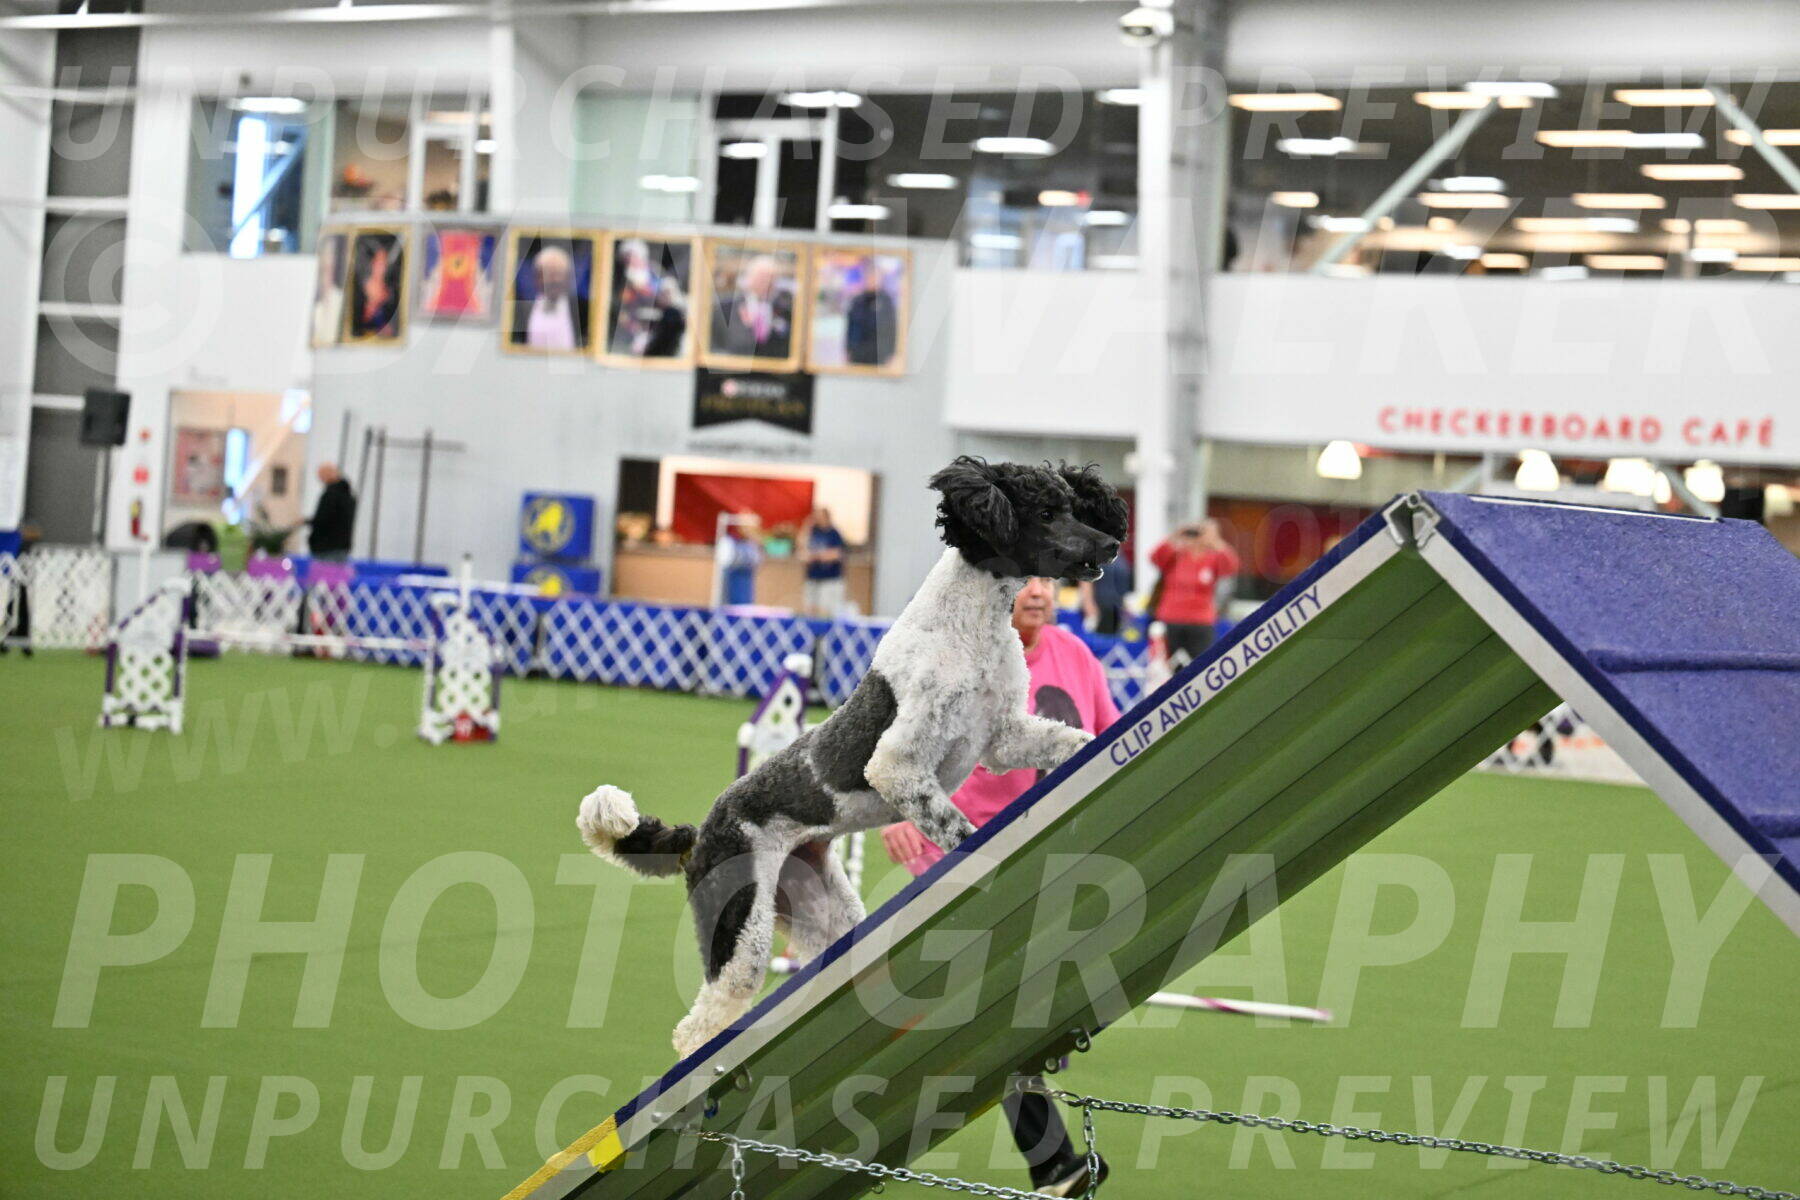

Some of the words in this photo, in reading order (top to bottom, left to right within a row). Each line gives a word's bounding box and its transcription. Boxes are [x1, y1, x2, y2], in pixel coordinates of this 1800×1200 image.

[1378, 406, 1663, 444] CHECKERBOARD
[1682, 416, 1775, 448] CAFÉ
[1110, 720, 1153, 766] CLIP
[1159, 685, 1201, 732] AND
[1205, 656, 1237, 692] GO
[1242, 585, 1322, 666] AGILITY
